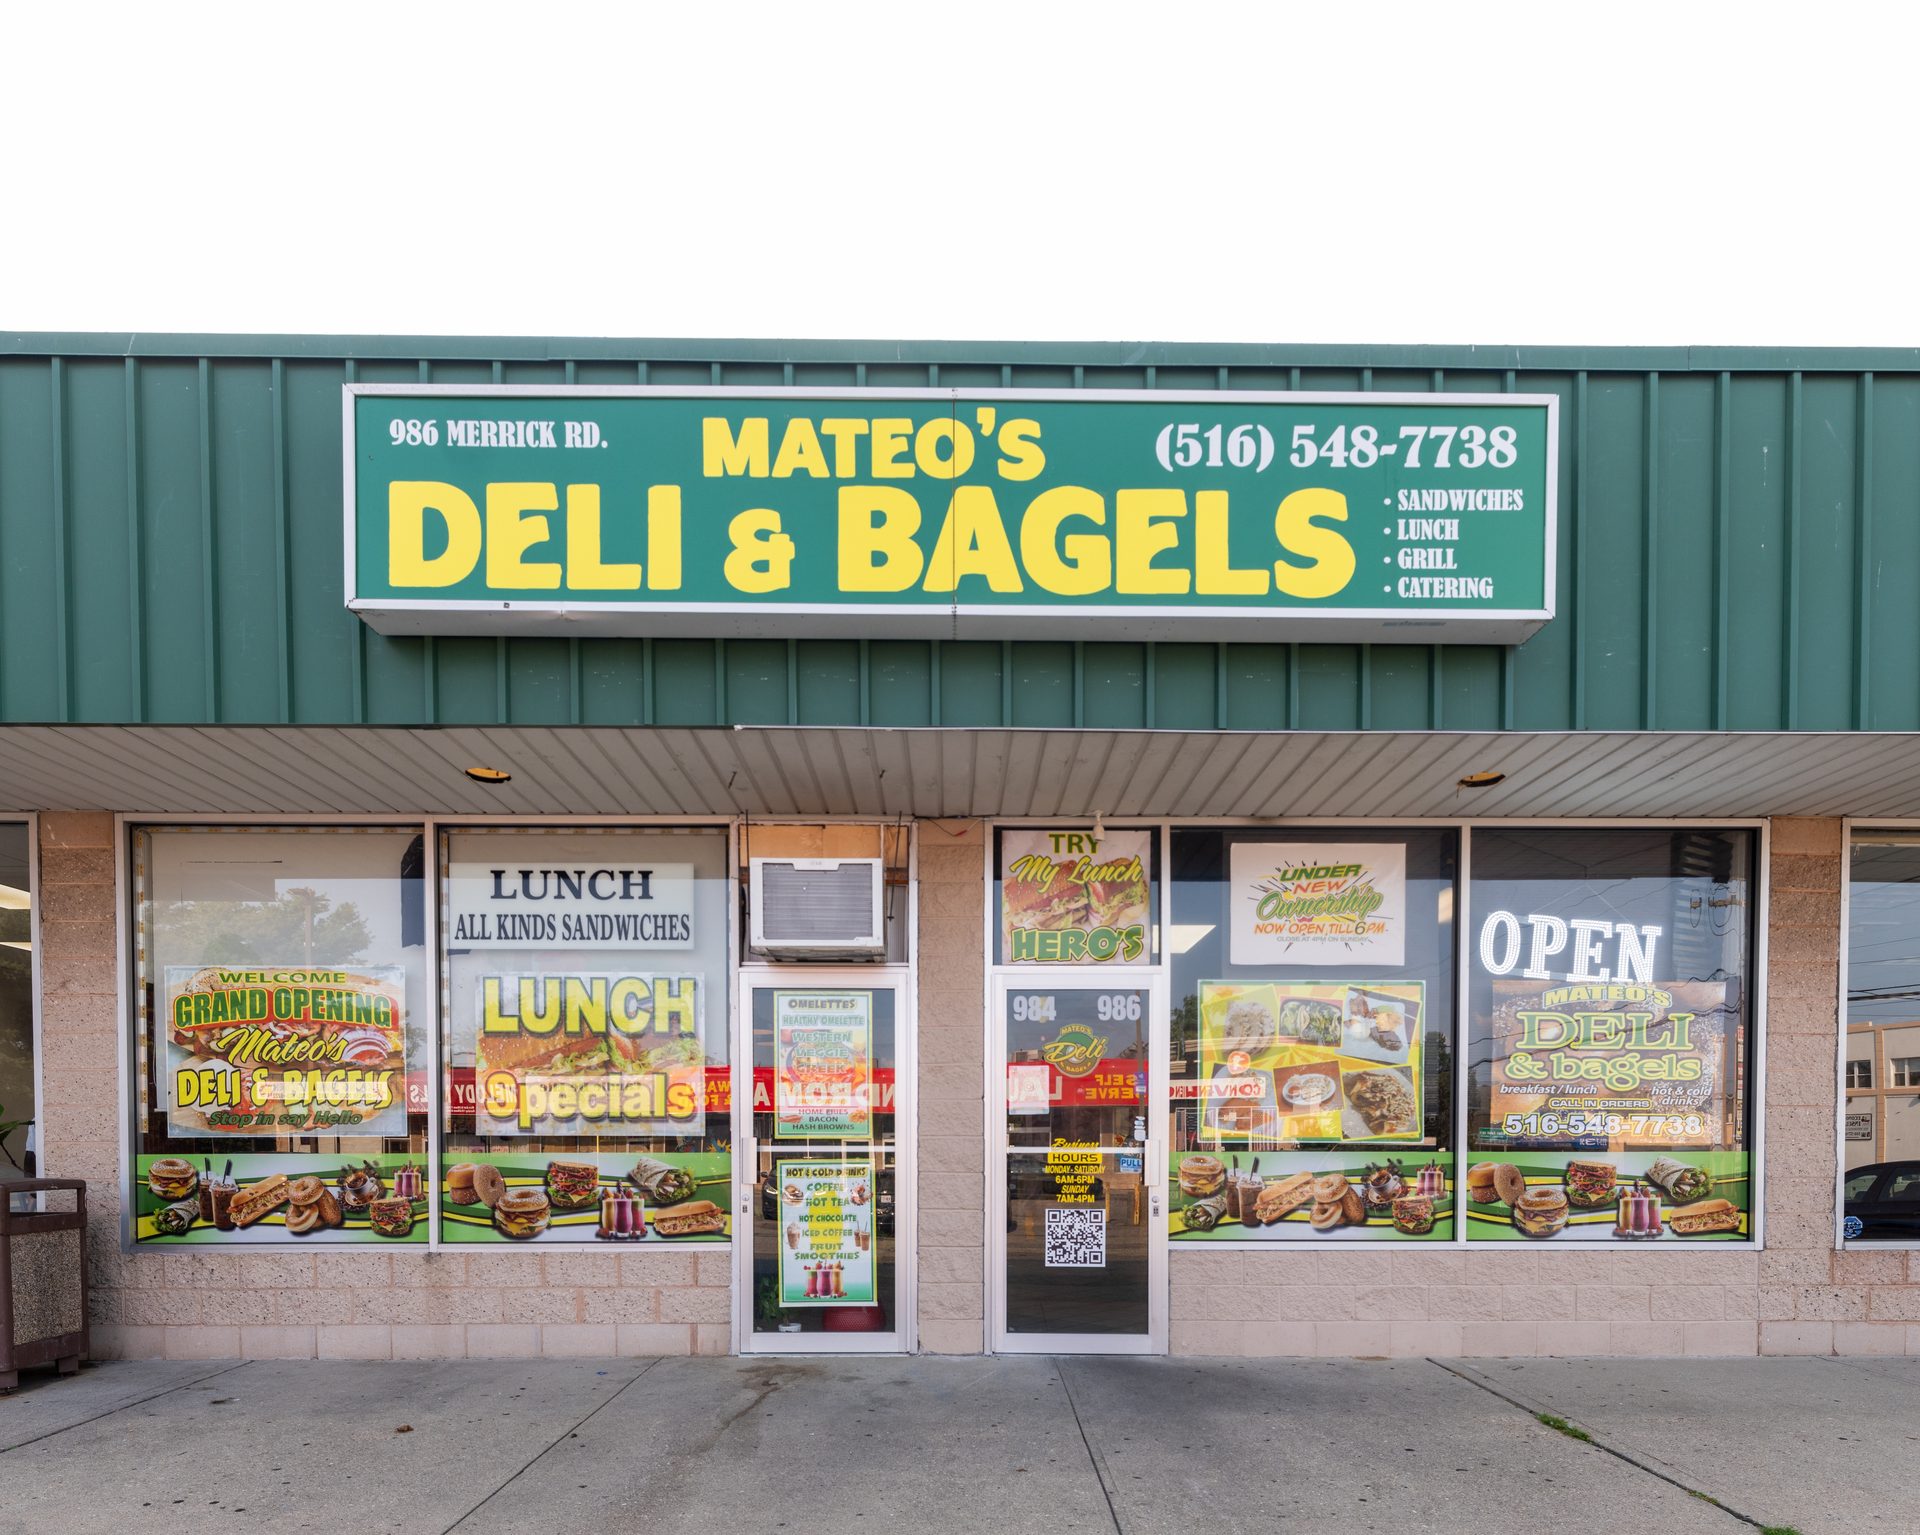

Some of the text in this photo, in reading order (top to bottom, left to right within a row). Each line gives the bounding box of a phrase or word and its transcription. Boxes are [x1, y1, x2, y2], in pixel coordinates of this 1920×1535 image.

[389, 419, 609, 449] 986 MERRICK RD.
[702, 407, 1046, 482] MATEO'S
[1155, 423, 1518, 473] (516) 548-7738
[1397, 488, 1524, 512] SANDWICHES
[388, 480, 1357, 599] DELI & BAGELS
[1397, 518, 1460, 541] LUNCH
[1397, 547, 1458, 570] GRILL
[1397, 576, 1494, 599] CATERING
[1048, 833, 1099, 854] TRY
[1009, 855, 1144, 893] My Lunch
[1279, 863, 1364, 882] UNDER
[490, 870, 654, 900] LUNCH
[1292, 879, 1348, 895] NEW
[1256, 884, 1385, 921] Ownership
[454, 914, 690, 941] ALL KINDS SANDWICHES
[1254, 923, 1286, 934] NOW
[1288, 923, 1324, 934] OPEN
[1329, 923, 1353, 934] TILL
[1011, 925, 1144, 962] HERO'S
[1480, 910, 1662, 983] OPEN
[218, 972, 346, 984] WELCOME
[174, 987, 393, 1029] GRAND OPENING
[483, 976, 697, 1035] LUNCH
[1013, 995, 1056, 1021] 984
[1097, 995, 1140, 1020] 986
[1543, 985, 1672, 1008] MATEO'S
[820, 1015, 865, 1025] OMELETTE
[1515, 1011, 1696, 1050] DELI
[217, 1028, 350, 1065] Mateo's
[793, 1032, 851, 1042] WESTERN
[1044, 1038, 1106, 1061] Deli
[1505, 1052, 1702, 1091] & bagels
[176, 1068, 242, 1107] DELI
[283, 1068, 395, 1109] BAGELS
[484, 1070, 699, 1130] Specials
[1500, 1084, 1557, 1094] breakfast
[1564, 1084, 1598, 1095] lunch
[1651, 1086, 1712, 1097] hot & cold
[1551, 1100, 1650, 1108] CALL IN ORDERS
[1661, 1096, 1700, 1106] drinks
[208, 1110, 363, 1127] Stop in say Hello
[1503, 1113, 1703, 1136] 516-548-7738
[1051, 1138, 1099, 1150] Business
[1052, 1153, 1098, 1162] HOURS
[1121, 1158, 1141, 1167] PULL
[786, 1168, 804, 1177] HOT
[812, 1168, 834, 1177] COLD
[1045, 1165, 1070, 1174] MONDAY
[1074, 1165, 1105, 1174] SATURDAY
[1055, 1175, 1095, 1184] 6AM-6PM
[807, 1182, 844, 1191] COFFEE
[1061, 1185, 1090, 1193] SUNDAY
[806, 1198, 850, 1206] HOT TEA
[1056, 1194, 1095, 1203] 7AM-4PM
[802, 1229, 853, 1237] ICED COFFEE
[794, 1252, 860, 1260] SMOOTHIES
[810, 1243, 844, 1251] FRUIT
